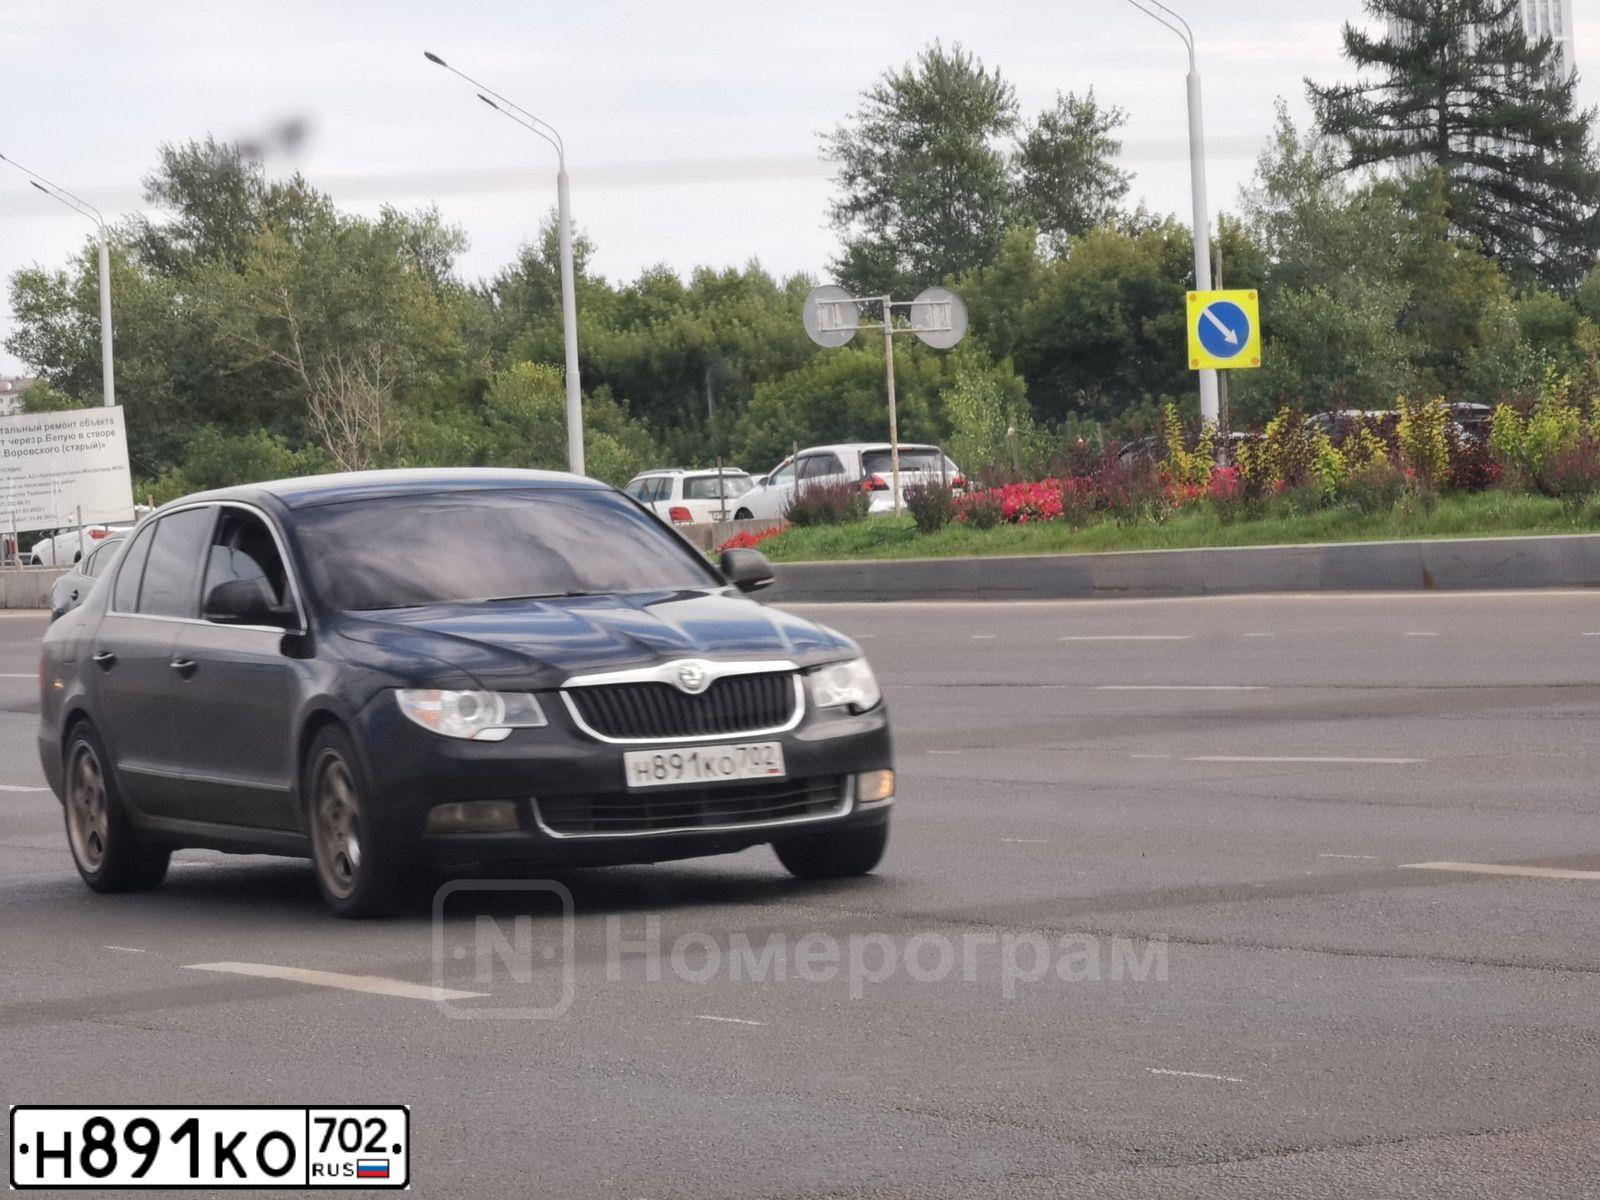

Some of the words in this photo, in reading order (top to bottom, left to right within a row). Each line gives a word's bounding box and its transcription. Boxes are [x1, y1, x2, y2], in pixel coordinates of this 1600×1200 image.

[44, 421, 76, 432] ремонт
[79, 417, 114, 428] объекта
[8, 436, 36, 446] через
[78, 432, 84, 440] в
[86, 430, 116, 439] створе
[736, 745, 775, 767] 702
